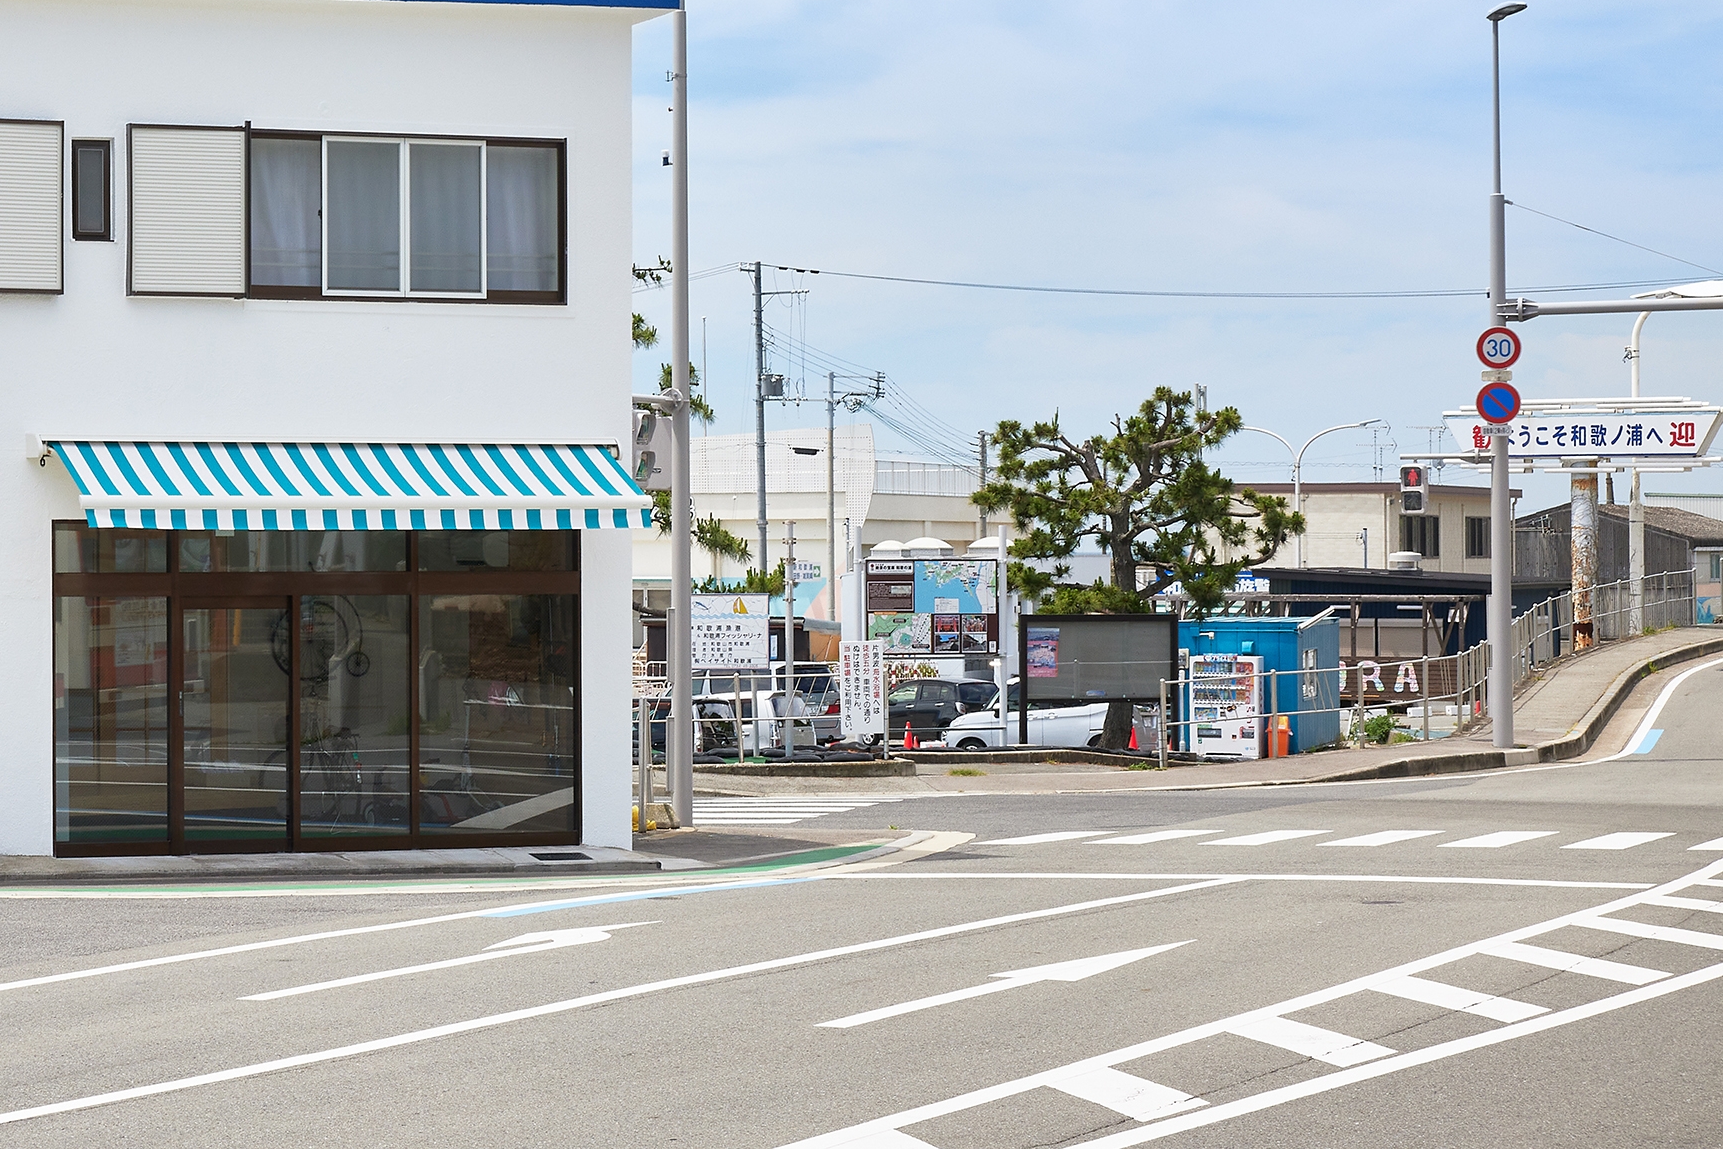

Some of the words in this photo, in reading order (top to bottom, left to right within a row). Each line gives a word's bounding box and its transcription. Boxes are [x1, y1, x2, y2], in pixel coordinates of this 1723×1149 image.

[1486, 338, 1511, 358] 30
[1508, 424, 1664, 447] うこそ和歌ノ浦へ
[1669, 422, 1696, 448] 迎
